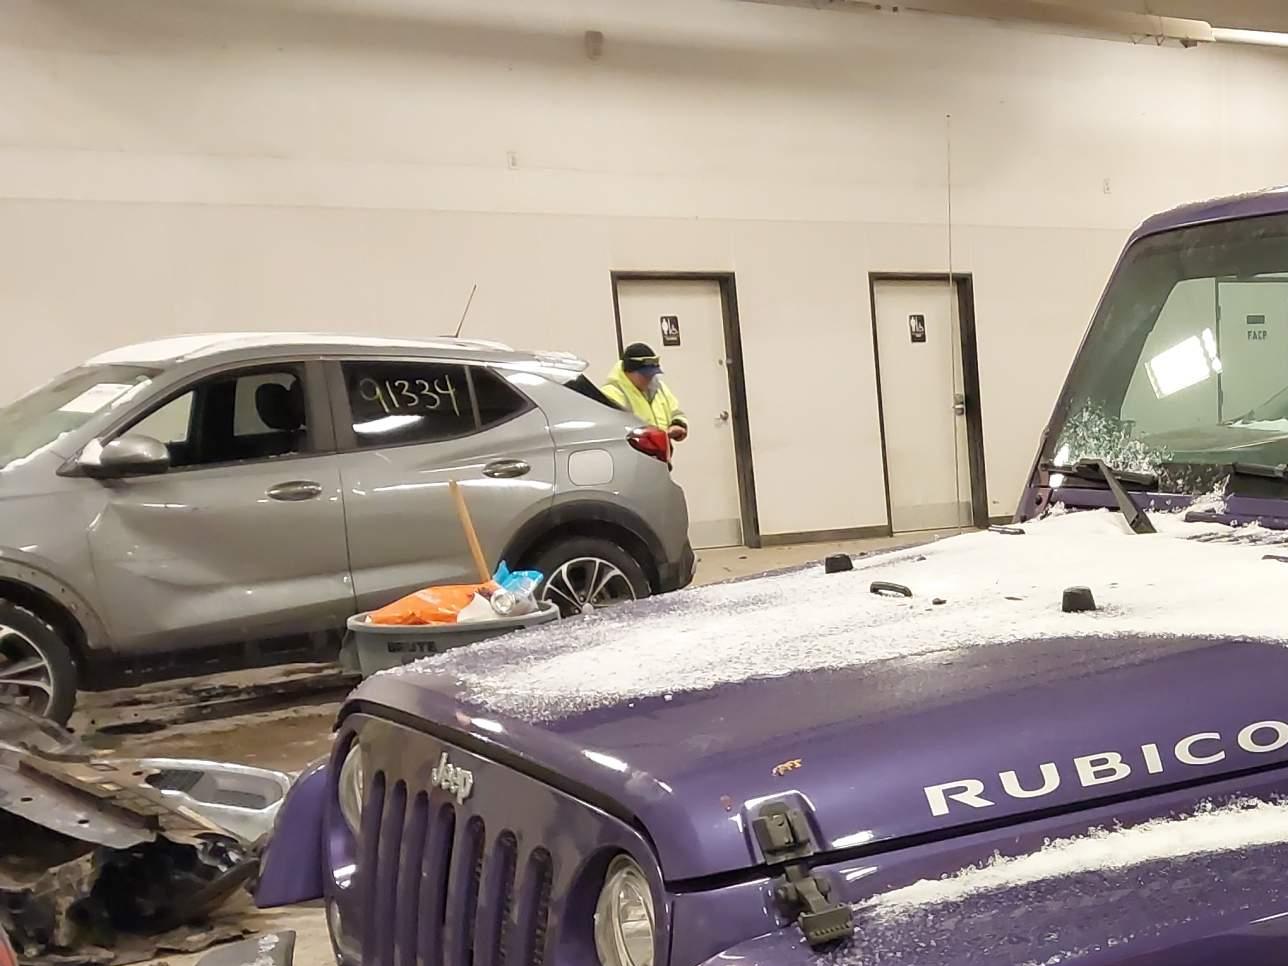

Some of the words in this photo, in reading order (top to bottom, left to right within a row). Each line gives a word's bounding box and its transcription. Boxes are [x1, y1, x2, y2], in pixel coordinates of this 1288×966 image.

[1247, 330, 1267, 340] FACP
[359, 374, 460, 416] 91334
[432, 752, 473, 805] Jeep
